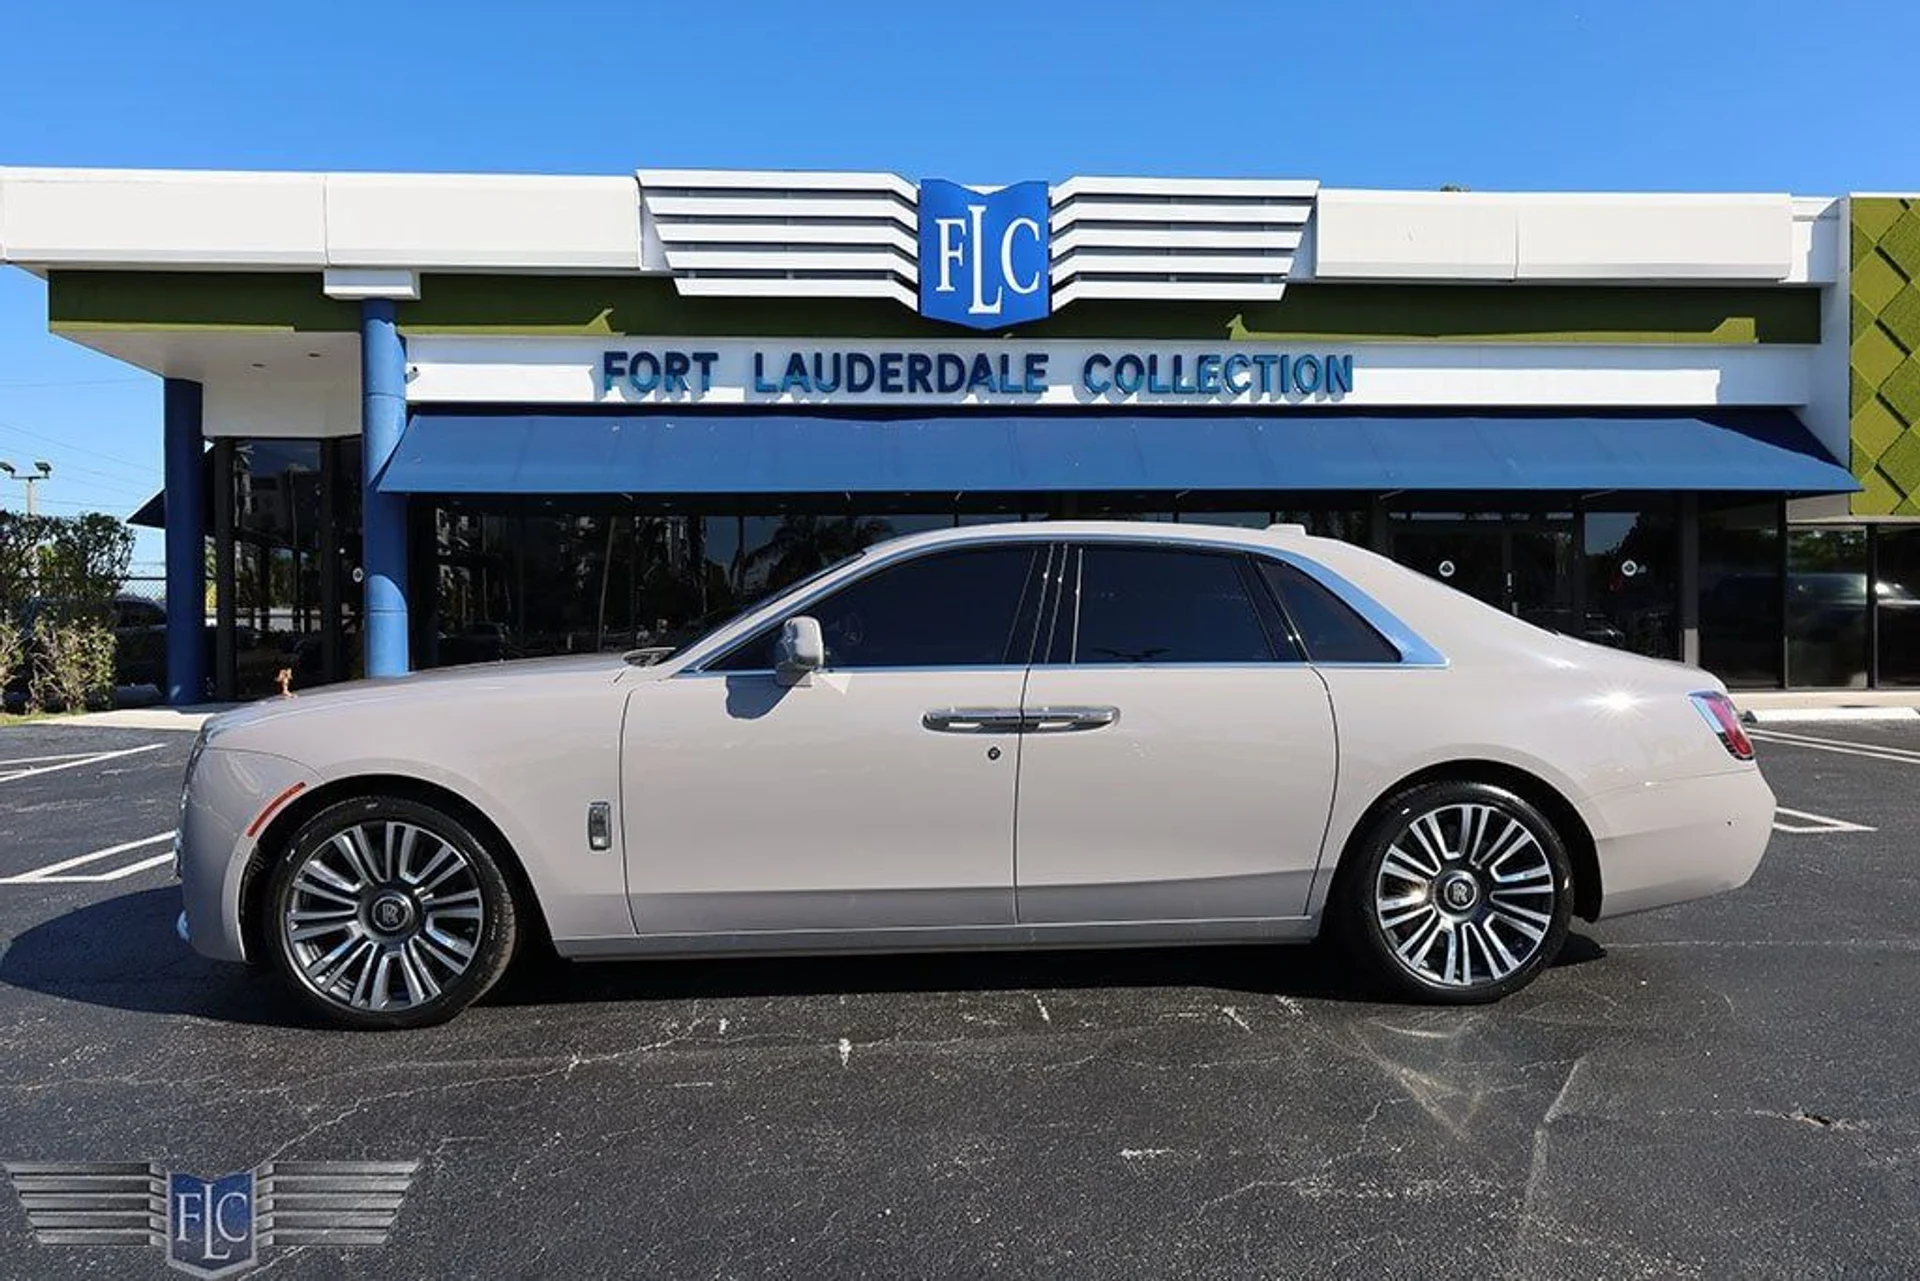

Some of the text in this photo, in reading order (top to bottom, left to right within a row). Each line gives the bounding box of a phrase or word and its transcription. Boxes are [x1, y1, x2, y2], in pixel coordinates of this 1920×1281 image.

[935, 204, 1041, 314] FLC
[603, 351, 1353, 394] FORT LAUDERDALE COLLECTION
